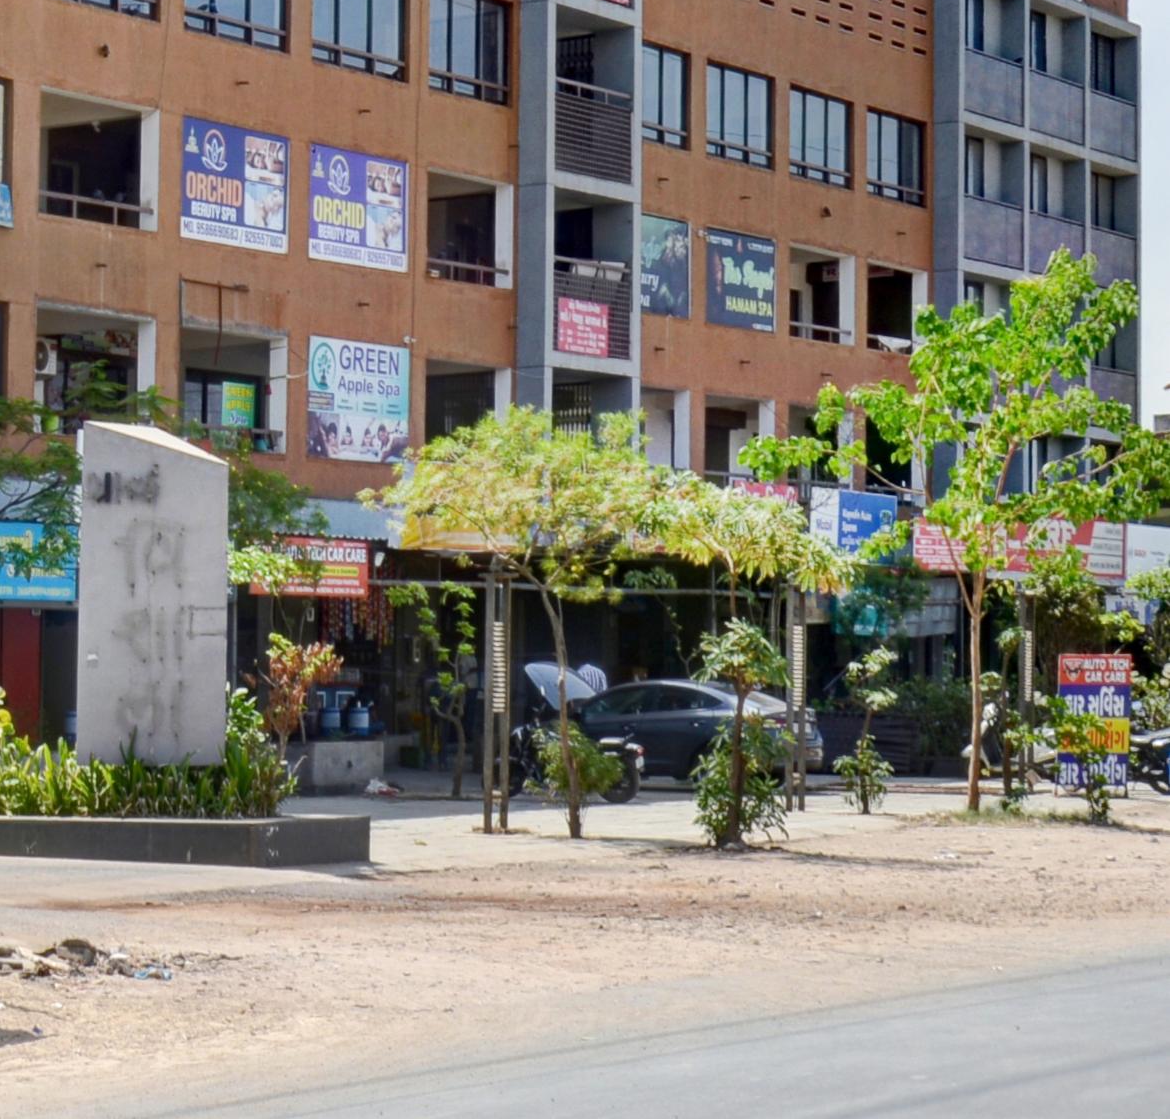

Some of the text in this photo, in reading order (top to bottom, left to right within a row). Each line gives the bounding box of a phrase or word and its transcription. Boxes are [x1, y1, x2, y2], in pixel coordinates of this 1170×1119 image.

[186, 171, 243, 208] ORCHID
[191, 200, 238, 223] BEAUTY SPA
[313, 194, 366, 230] ORCHID
[317, 224, 361, 245] BEAUTY SPA
[339, 344, 400, 376] GREEN
[337, 376, 400, 399] Apple Spa
[327, 547, 344, 562] CAR
[345, 548, 367, 564] CARE
[1082, 659, 1130, 670] AUTO TECH
[1085, 671, 1127, 683] CAR CARE
